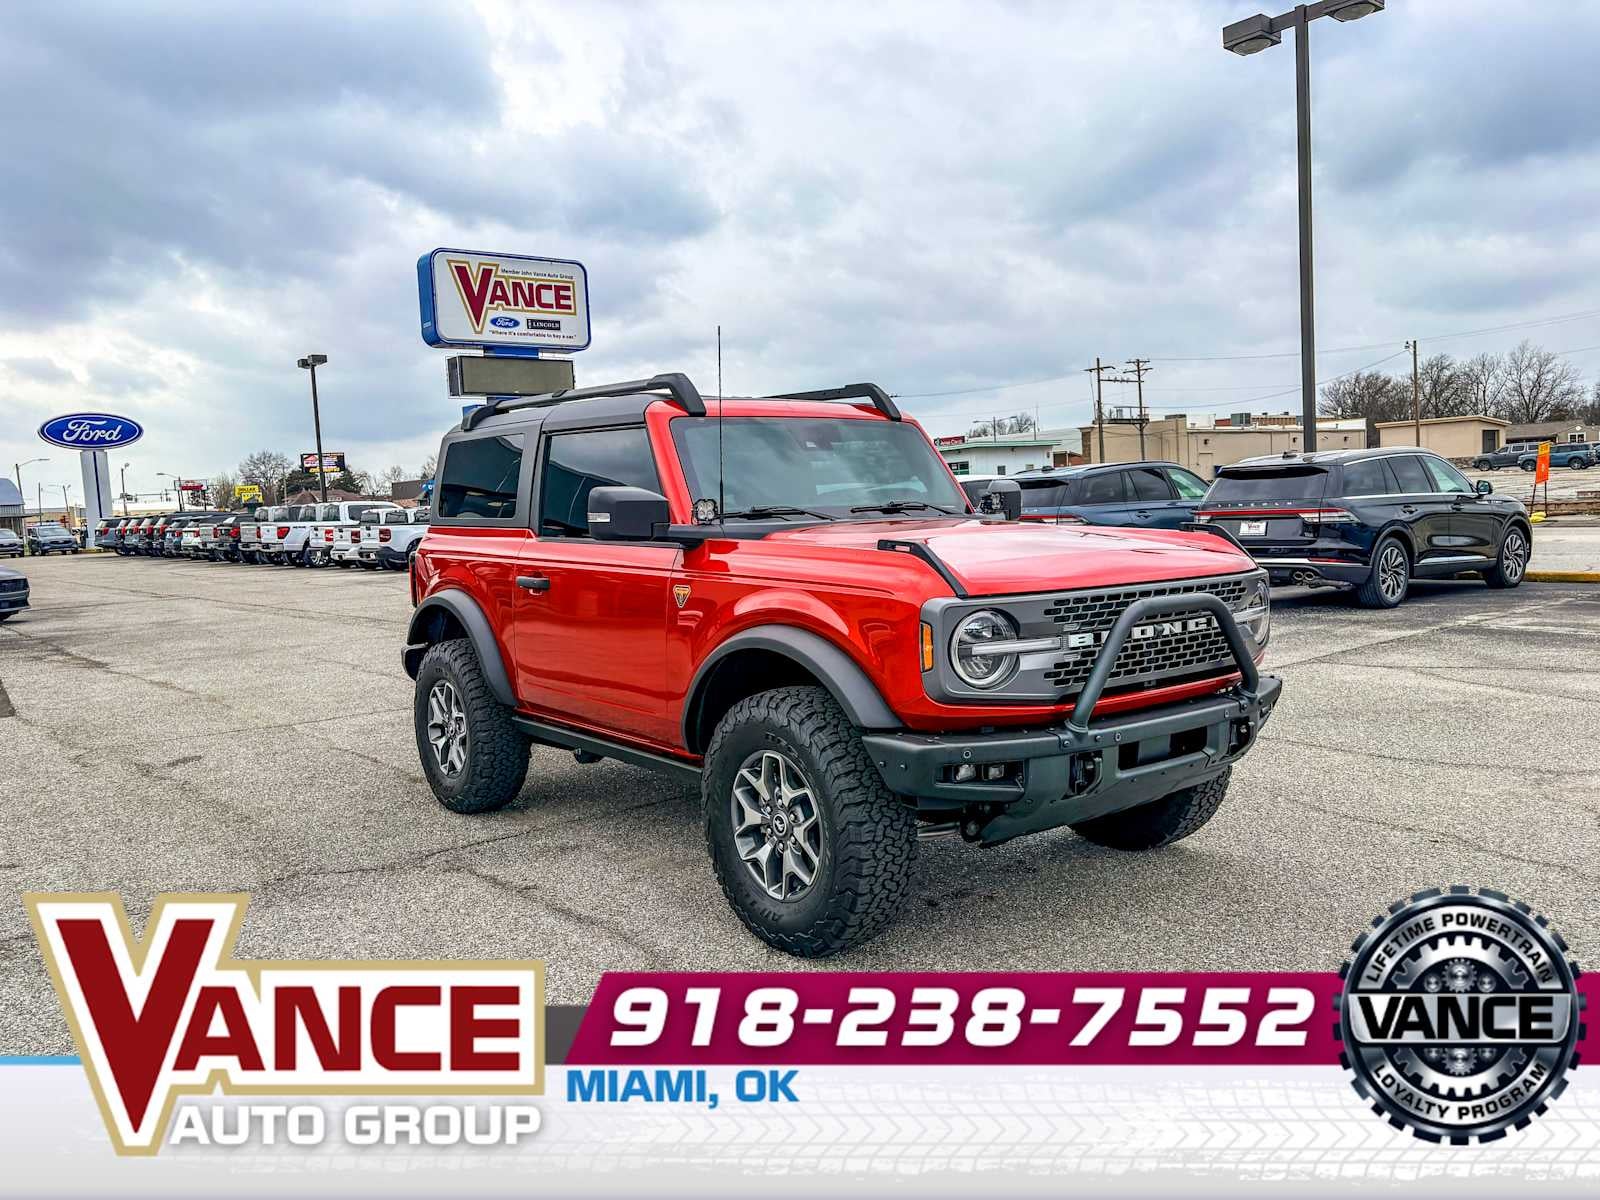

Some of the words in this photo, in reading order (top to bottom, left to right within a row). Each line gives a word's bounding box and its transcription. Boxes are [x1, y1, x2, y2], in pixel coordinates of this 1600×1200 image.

[454, 265, 573, 329] VANCE
[496, 317, 515, 327] Ford
[62, 419, 122, 441] Ford
